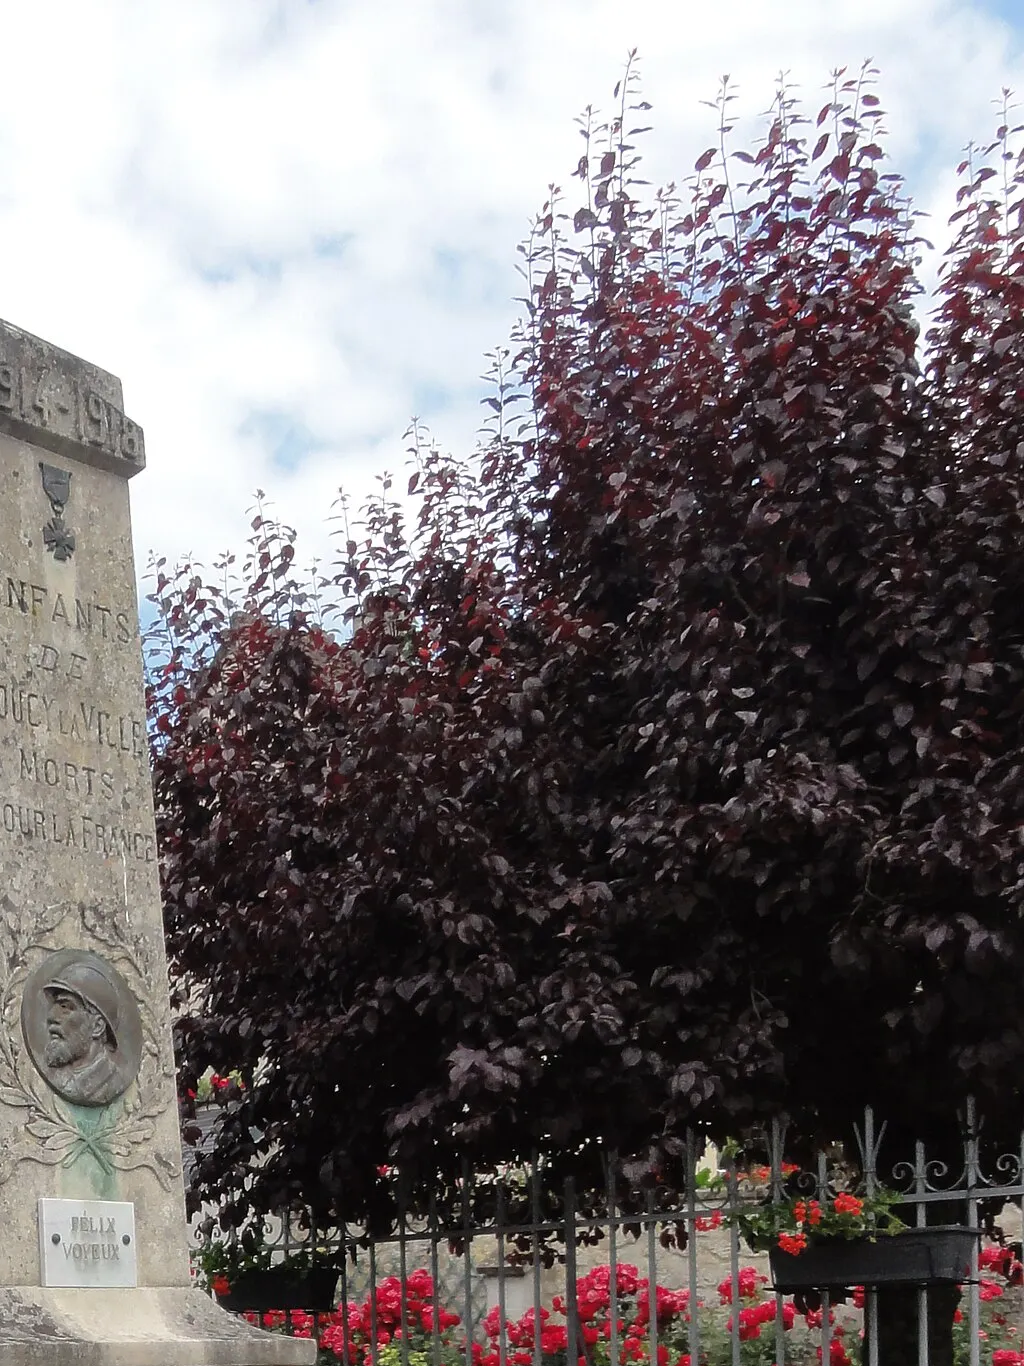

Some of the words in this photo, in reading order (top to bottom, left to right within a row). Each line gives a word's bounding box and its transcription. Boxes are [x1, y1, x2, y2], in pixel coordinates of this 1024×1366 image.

[36, 645, 88, 680] DE
[59, 710, 81, 740] LA
[80, 701, 143, 759] VILLE
[19, 749, 116, 800] MORTS
[53, 814, 76, 847] LA
[81, 815, 155, 863] FRANCE
[71, 1210, 116, 1234] FÉLIX
[62, 1242, 120, 1261] VOYEUX
